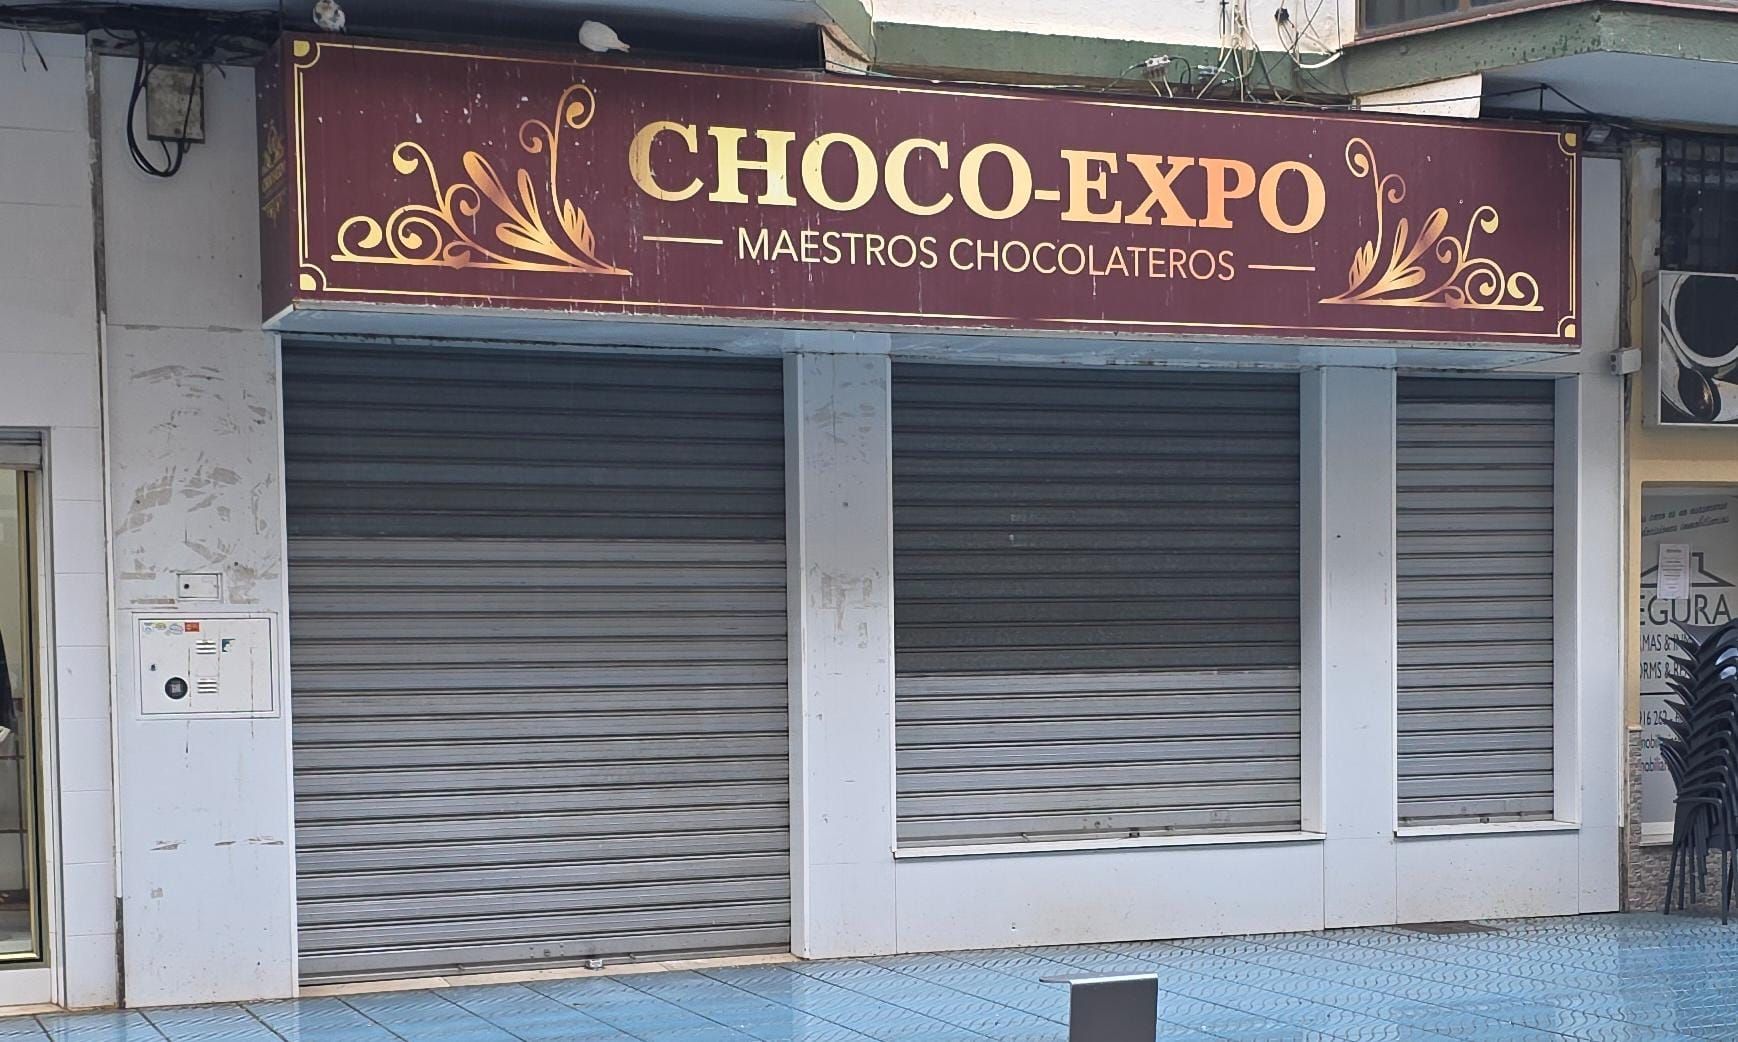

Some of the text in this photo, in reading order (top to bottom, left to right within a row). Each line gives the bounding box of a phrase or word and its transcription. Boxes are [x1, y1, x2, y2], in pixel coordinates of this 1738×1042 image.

[628, 120, 1326, 234] CHOCO-EXPO
[737, 226, 1236, 281] MAESTROS CHOCOLATEROS
[1640, 661, 1661, 680] RMS
[1640, 710, 1652, 725] 16
